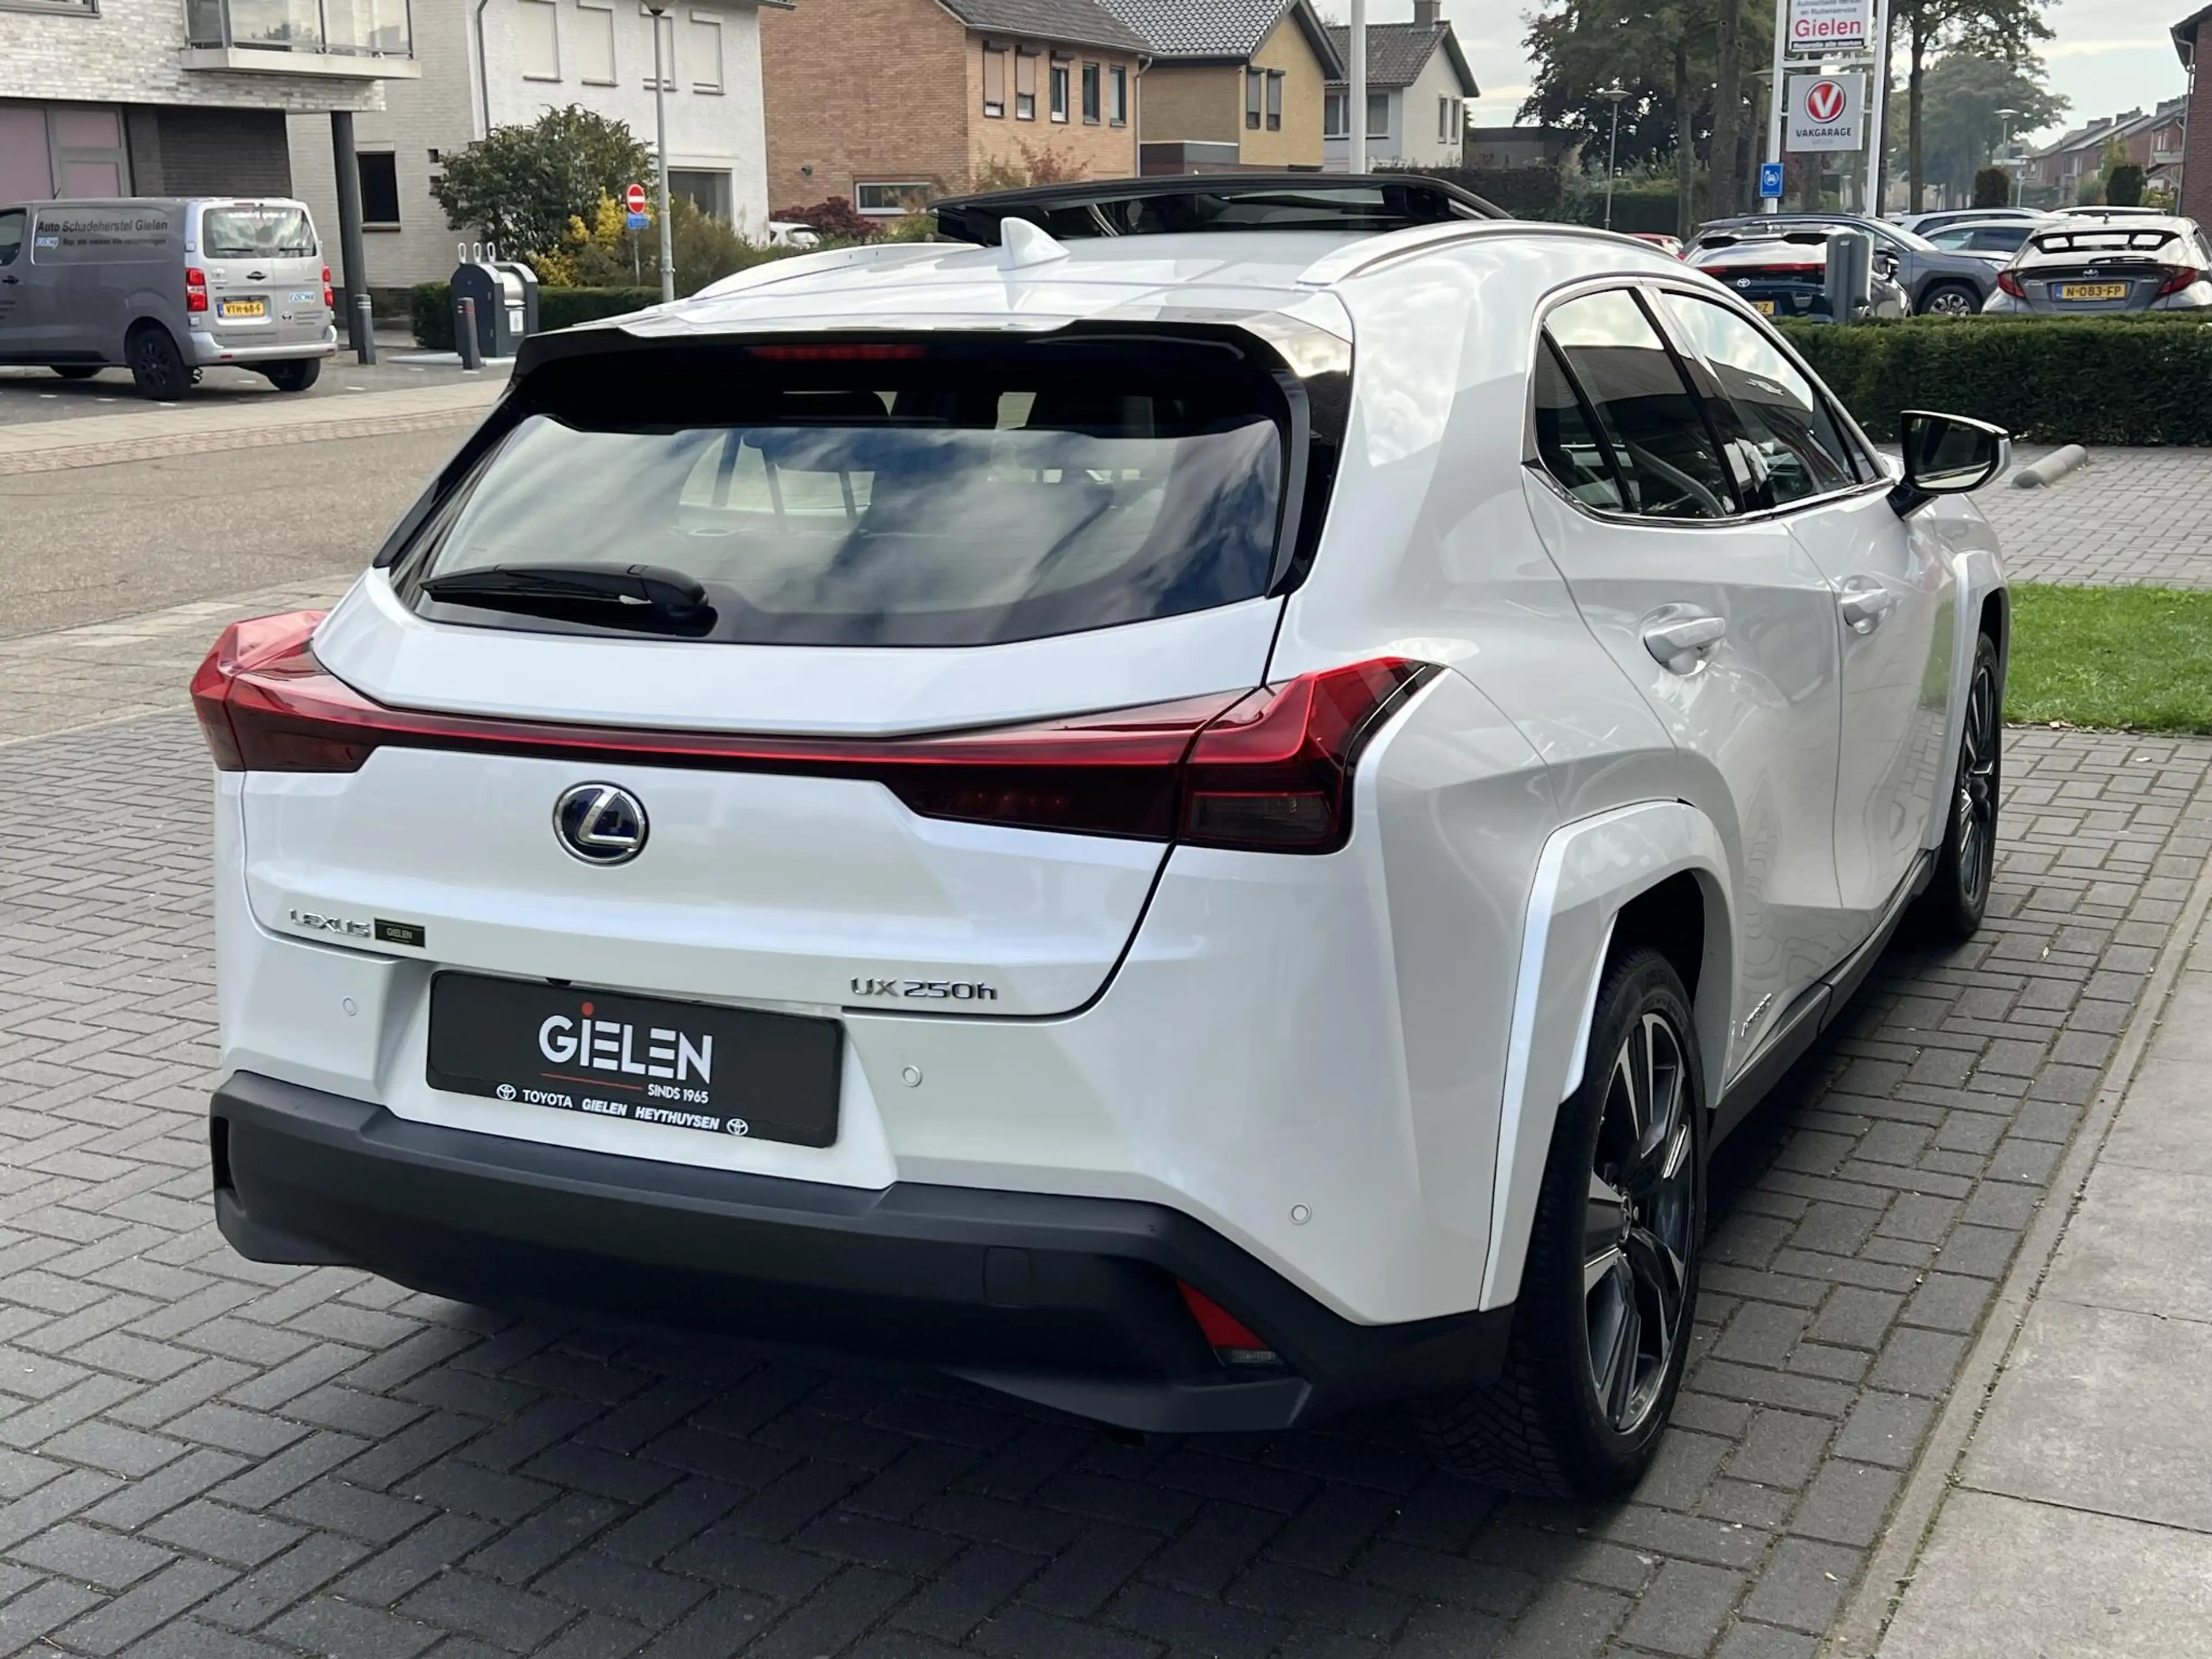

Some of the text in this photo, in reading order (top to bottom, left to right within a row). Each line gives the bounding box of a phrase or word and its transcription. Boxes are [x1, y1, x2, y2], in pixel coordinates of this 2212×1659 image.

[1795, 18, 1861, 37] Gielen
[1813, 84, 1840, 118] V
[1796, 127, 1852, 138] VAKGARAGE
[37, 219, 168, 232] Auto Schadeherstel Gielen
[2066, 285, 2122, 297] N-083-FP
[289, 908, 372, 938] LEXUS
[387, 927, 413, 940] GIELEN
[850, 977, 998, 1000] UX 250h
[647, 1084, 709, 1104] SINDS 1965
[522, 1089, 720, 1130] TOYOTA GIELEN HEYTHUYSEN
